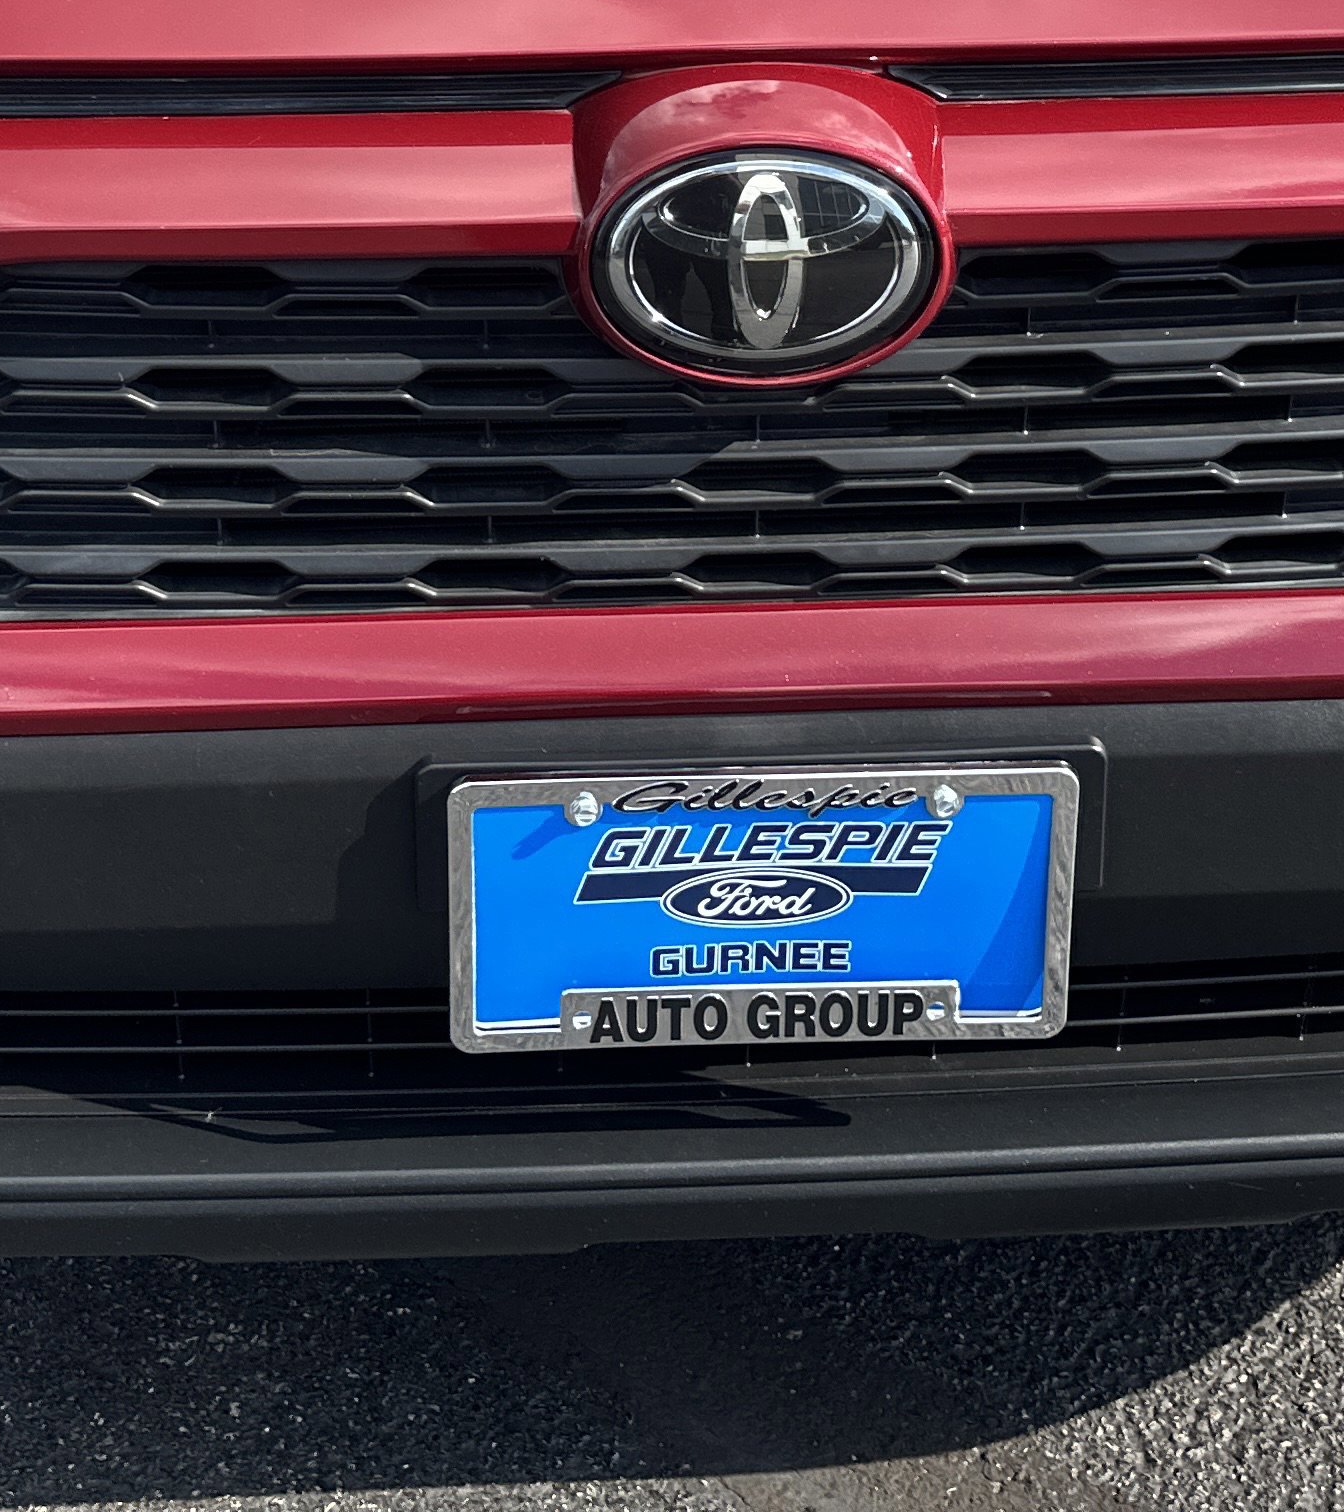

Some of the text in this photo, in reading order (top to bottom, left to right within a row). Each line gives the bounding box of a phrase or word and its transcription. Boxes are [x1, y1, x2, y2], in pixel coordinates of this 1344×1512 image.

[612, 778, 919, 819] Gillespie
[589, 820, 953, 870] GILLESPIE
[697, 876, 813, 917] Ford
[649, 939, 853, 978] GURNEE
[589, 989, 925, 1044] AUTO GROUP
